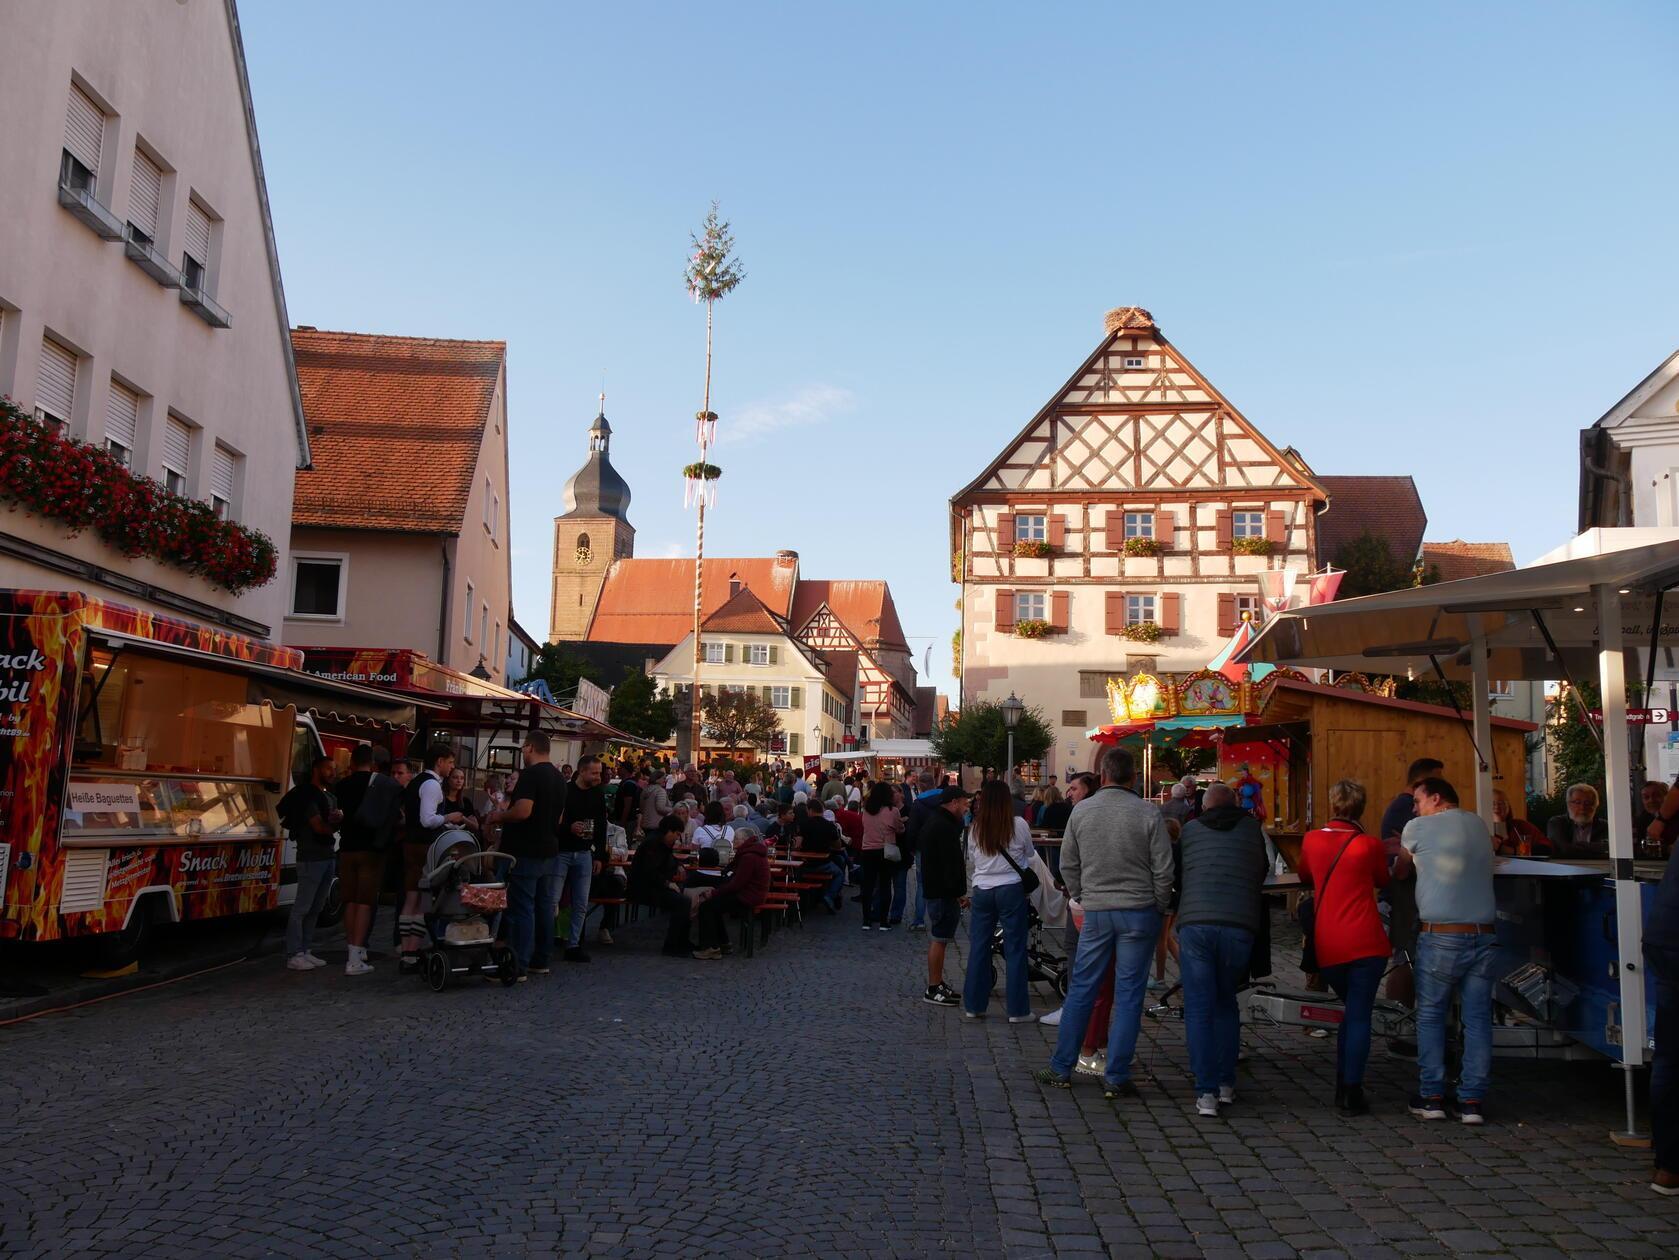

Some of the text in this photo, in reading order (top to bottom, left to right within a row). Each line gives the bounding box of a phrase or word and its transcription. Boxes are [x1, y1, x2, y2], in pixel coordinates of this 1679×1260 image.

[313, 670, 366, 681] American
[369, 672, 398, 682] Food
[71, 792, 134, 806] Heiße Baguettes
[178, 847, 276, 872] Snack Mobil
